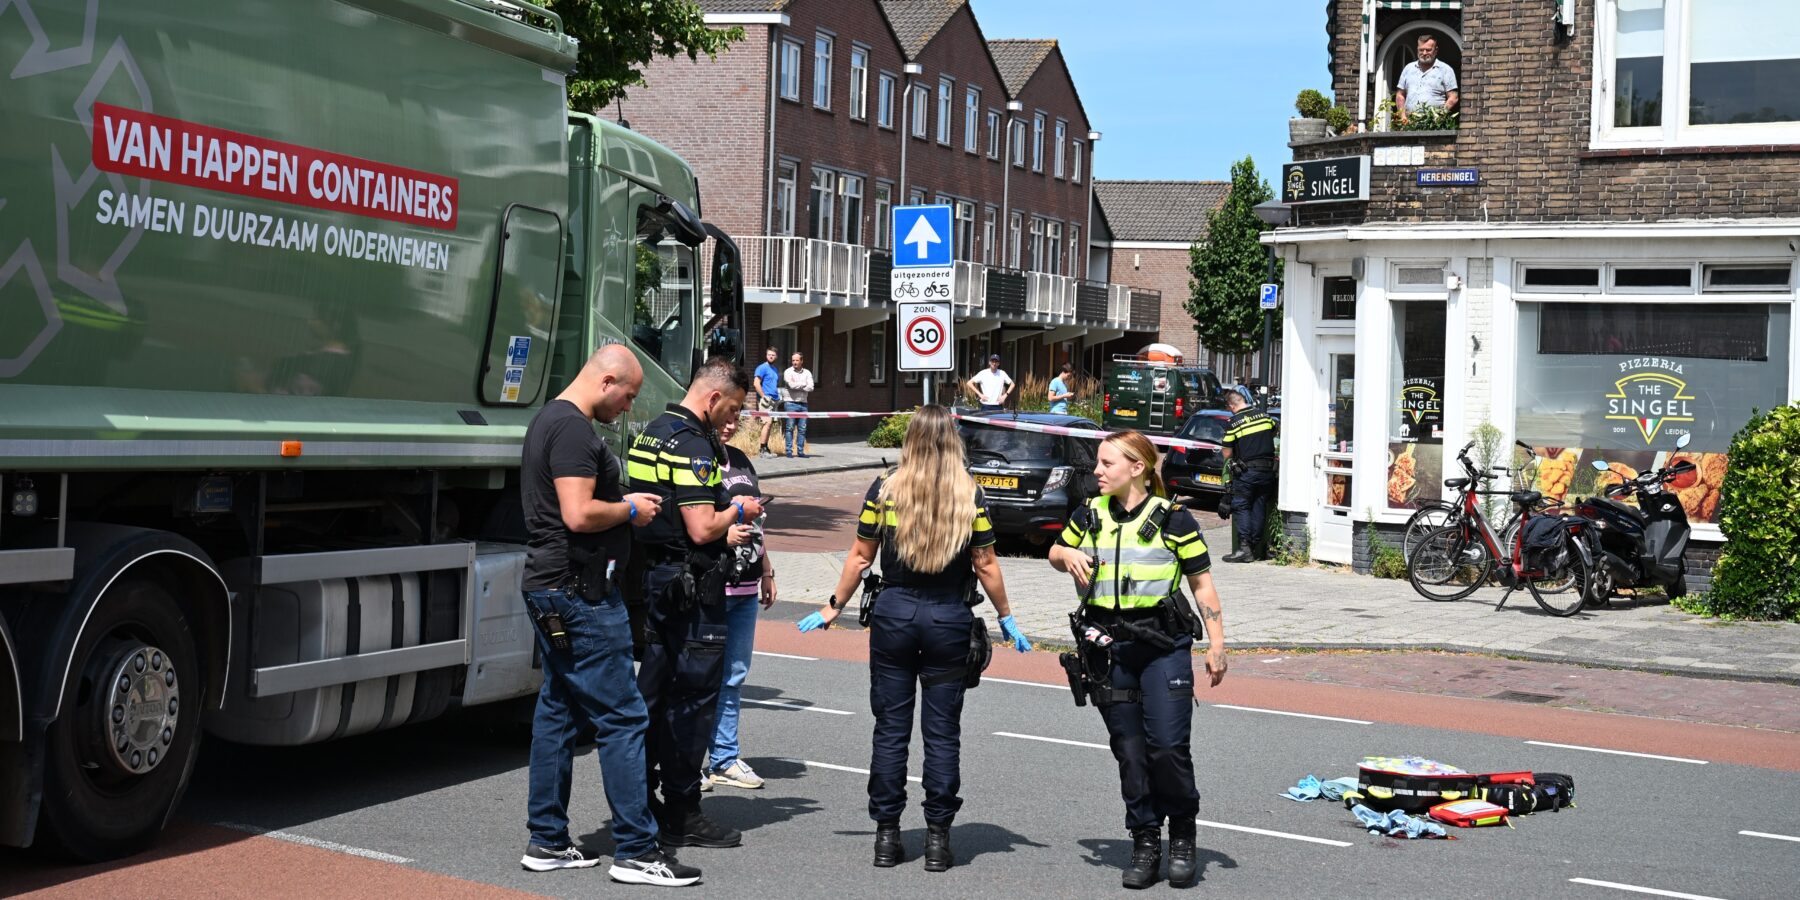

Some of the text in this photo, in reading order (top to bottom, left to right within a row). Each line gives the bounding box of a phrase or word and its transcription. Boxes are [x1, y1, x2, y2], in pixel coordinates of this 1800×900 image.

[103, 115, 453, 222] VAN HAPPEN CONTAINERS
[1325, 165, 1338, 177] THE
[1420, 172, 1475, 182] HERENSINGEL
[1311, 178, 1355, 197] SINGEL
[96, 189, 450, 271] SAMEN DUURZAAM ONDERNEMEN
[894, 270, 950, 280] uitgezonderd
[1263, 286, 1272, 299] P
[1332, 294, 1355, 302] WELKOM
[913, 328, 939, 344] 30
[1619, 358, 1683, 375] PIZZERIA
[1402, 378, 1435, 388] PIZZERIA
[1638, 385, 1661, 395] THE
[1396, 400, 1440, 410] SINGEL
[1608, 399, 1693, 416] SINGEL
[976, 476, 1014, 487] 59-XJT-6
